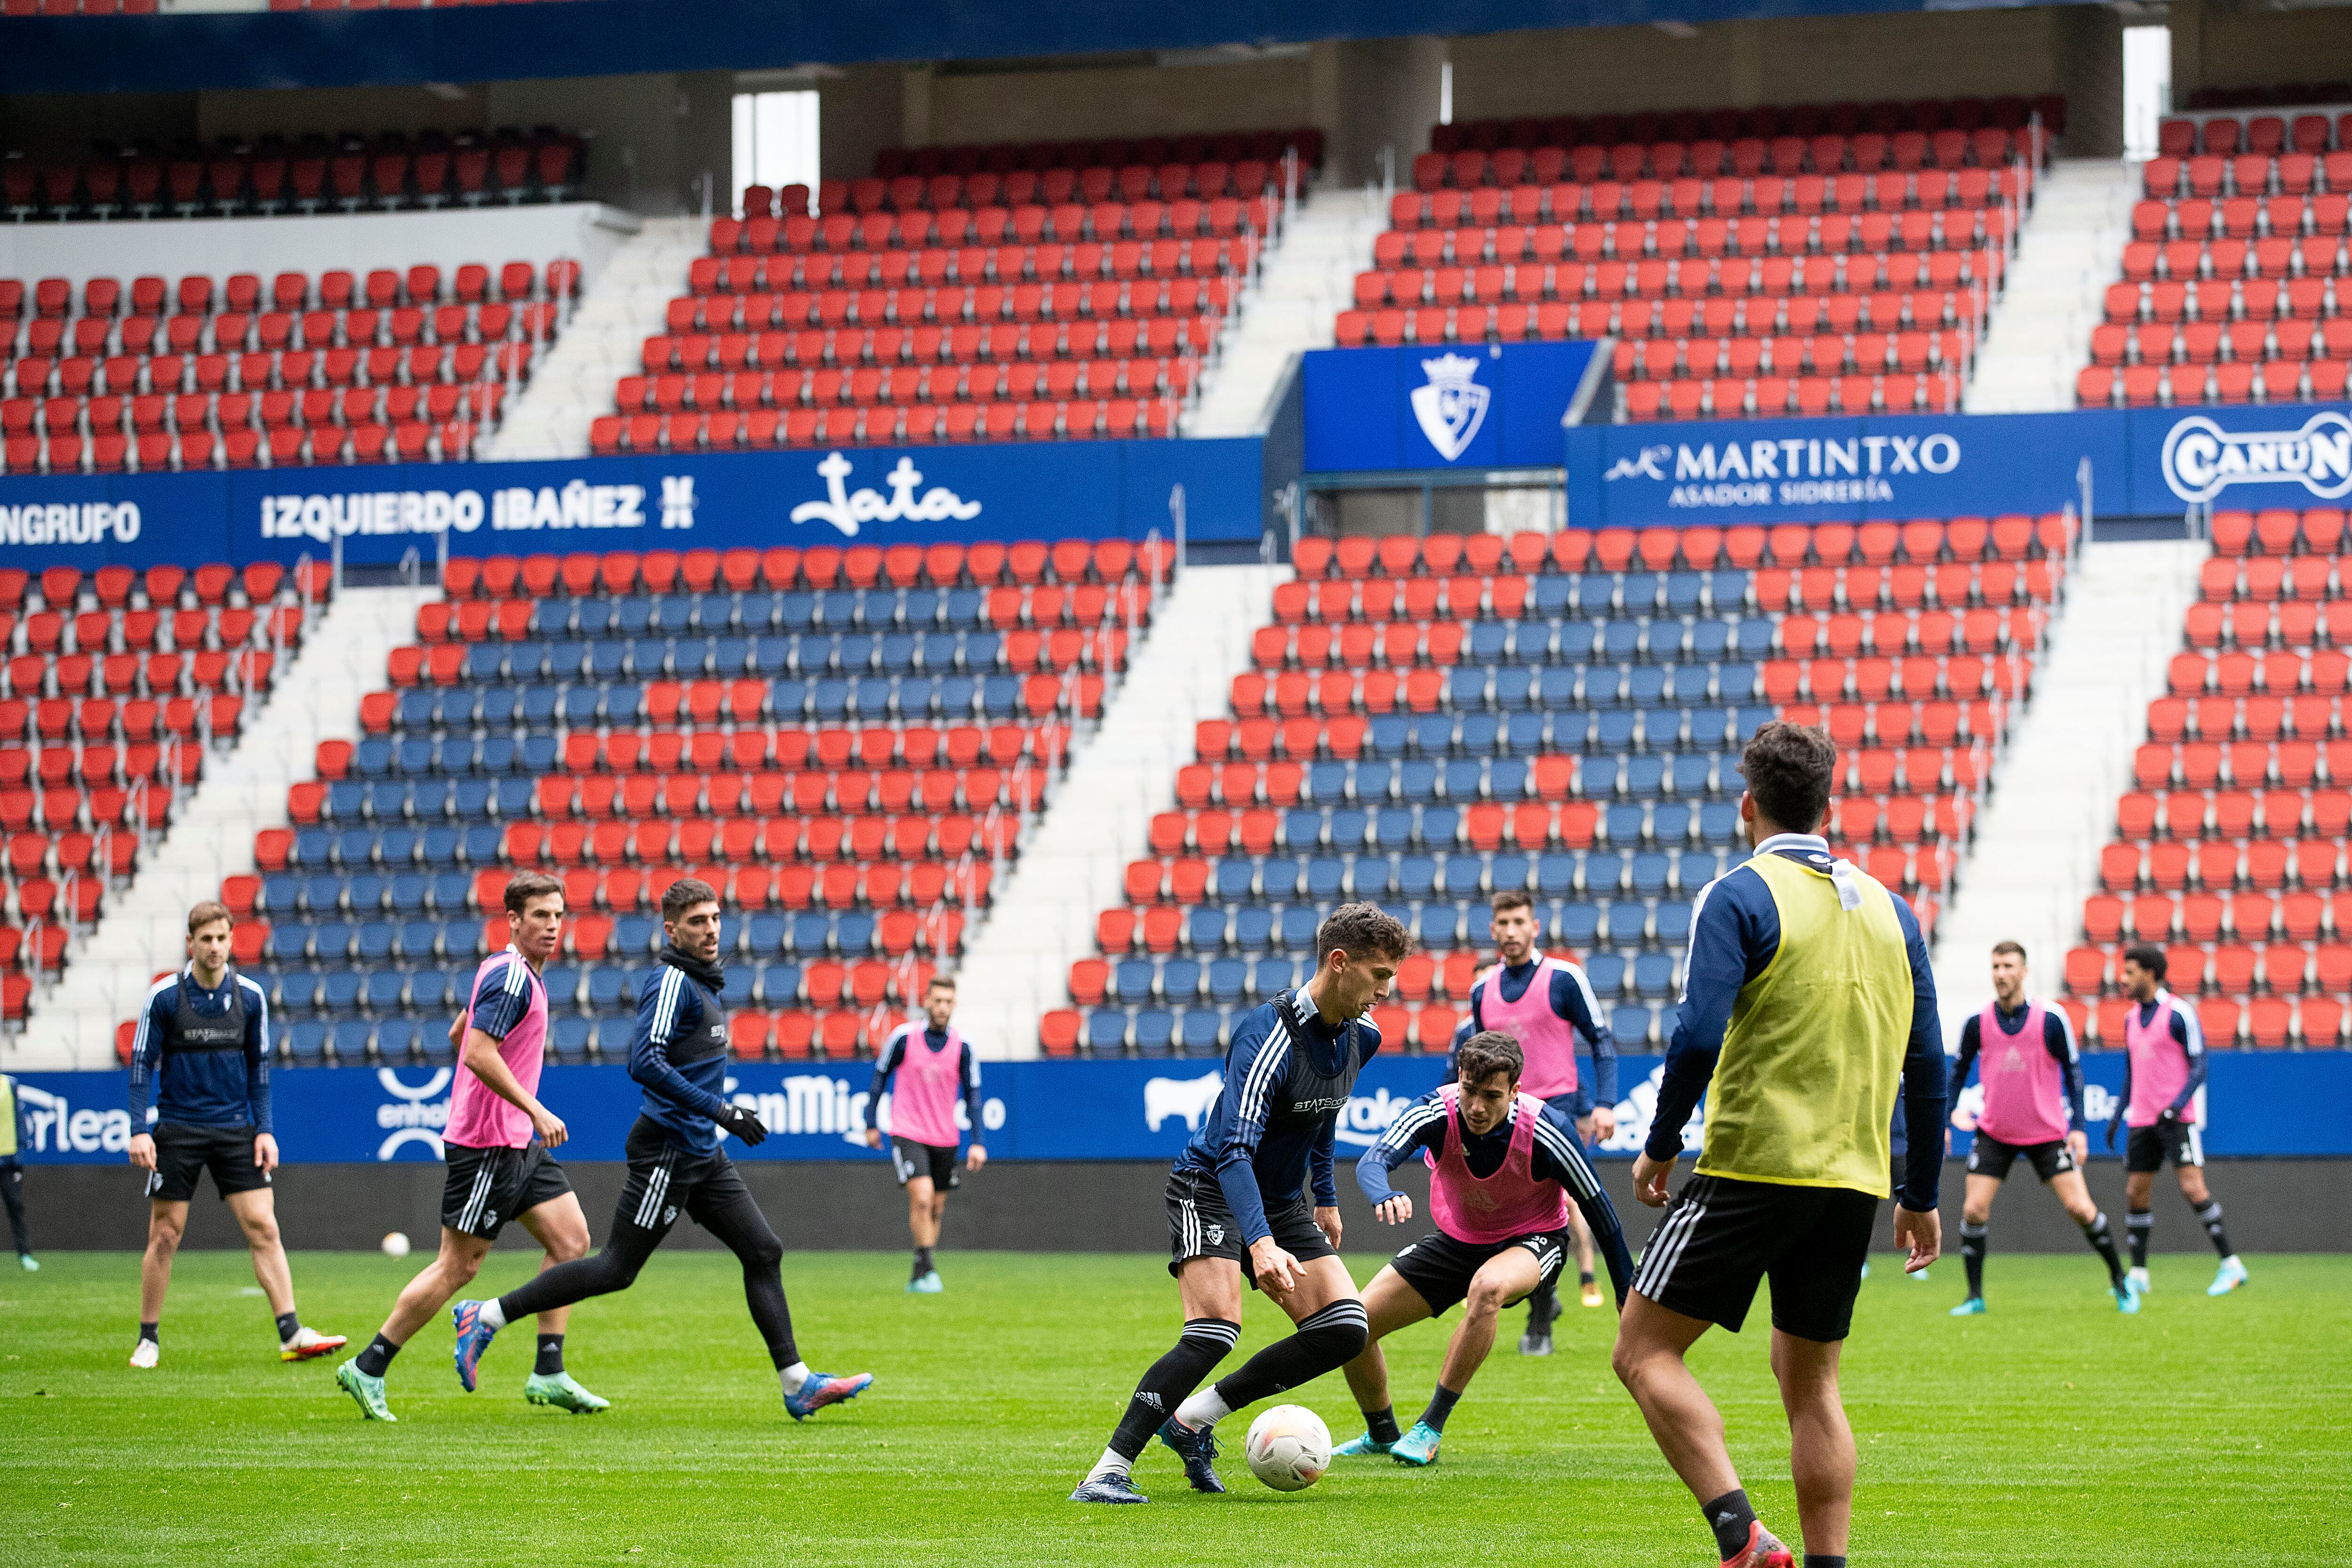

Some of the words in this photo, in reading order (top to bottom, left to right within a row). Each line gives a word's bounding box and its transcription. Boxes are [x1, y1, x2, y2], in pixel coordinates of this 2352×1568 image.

[1674, 433, 1961, 482] MARTINTXO
[2175, 430, 2352, 487] CANUN
[260, 489, 485, 543] IZQUIERDO
[492, 478, 646, 531] IBAÑEZ
[1667, 482, 1773, 509] ASADOR
[1135, 1391, 1166, 1413] adidas
